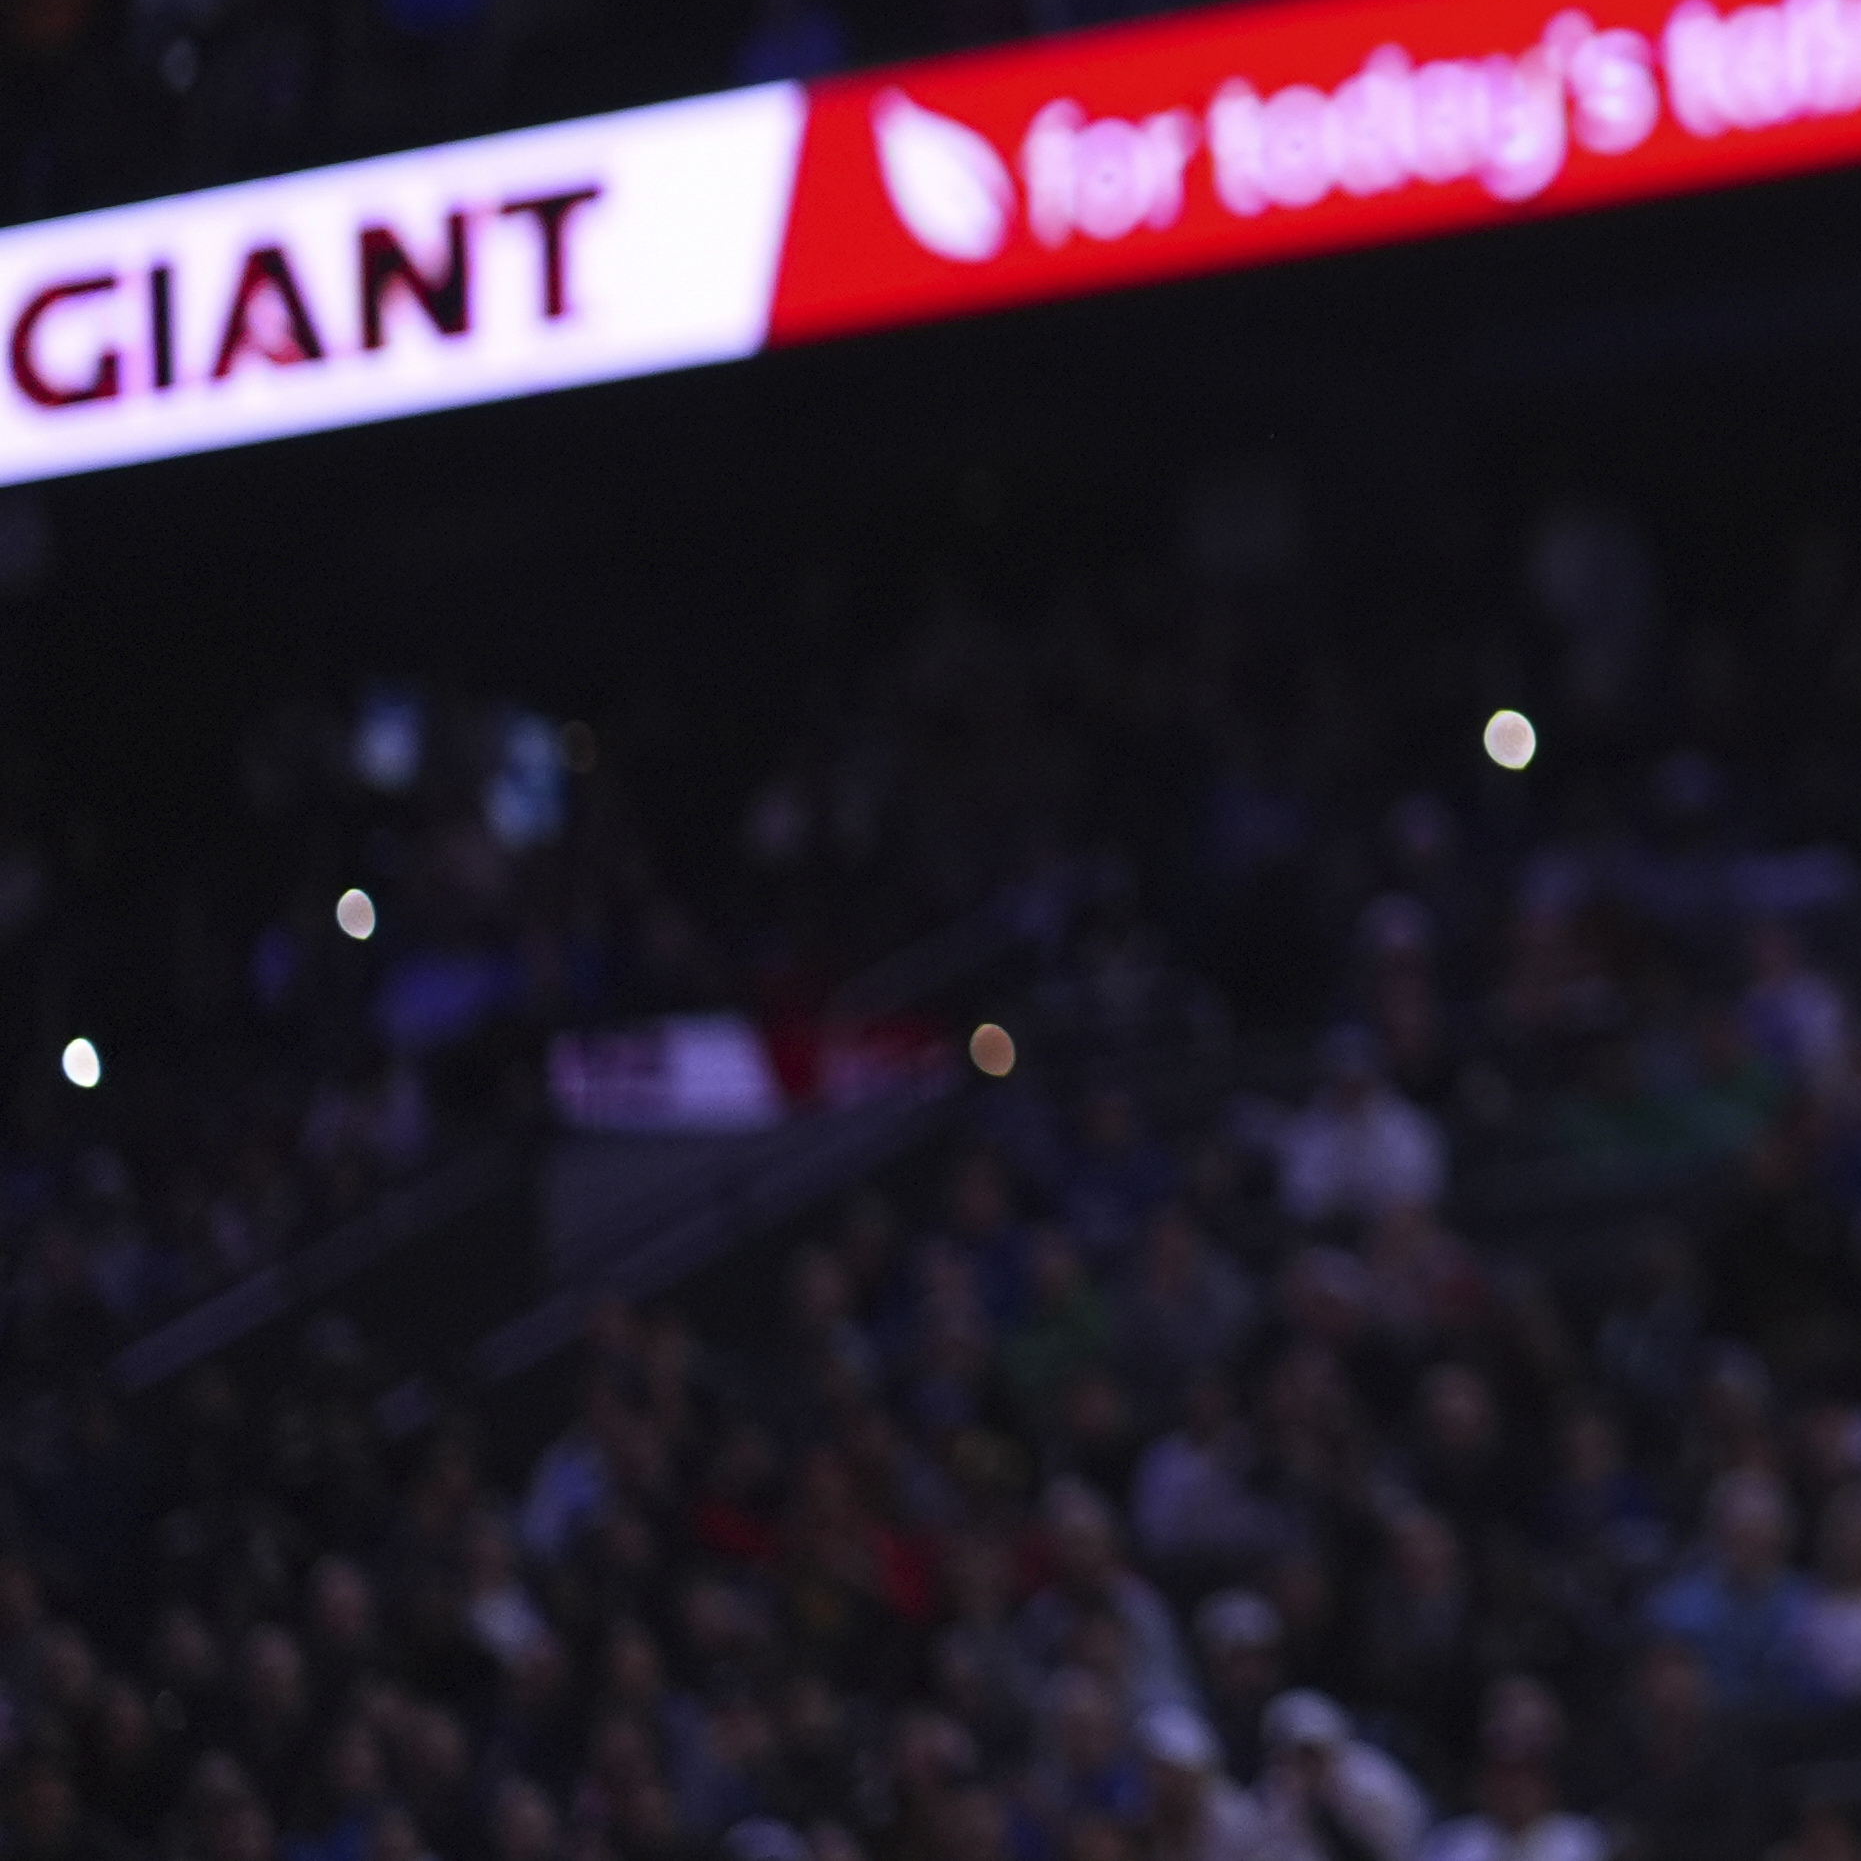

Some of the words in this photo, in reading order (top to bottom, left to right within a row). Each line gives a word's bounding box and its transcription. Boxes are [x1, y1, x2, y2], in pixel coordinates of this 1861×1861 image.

[1022, 96, 1198, 250] for
[1206, 8, 1660, 204] today's
[11, 186, 602, 409] GIANT
